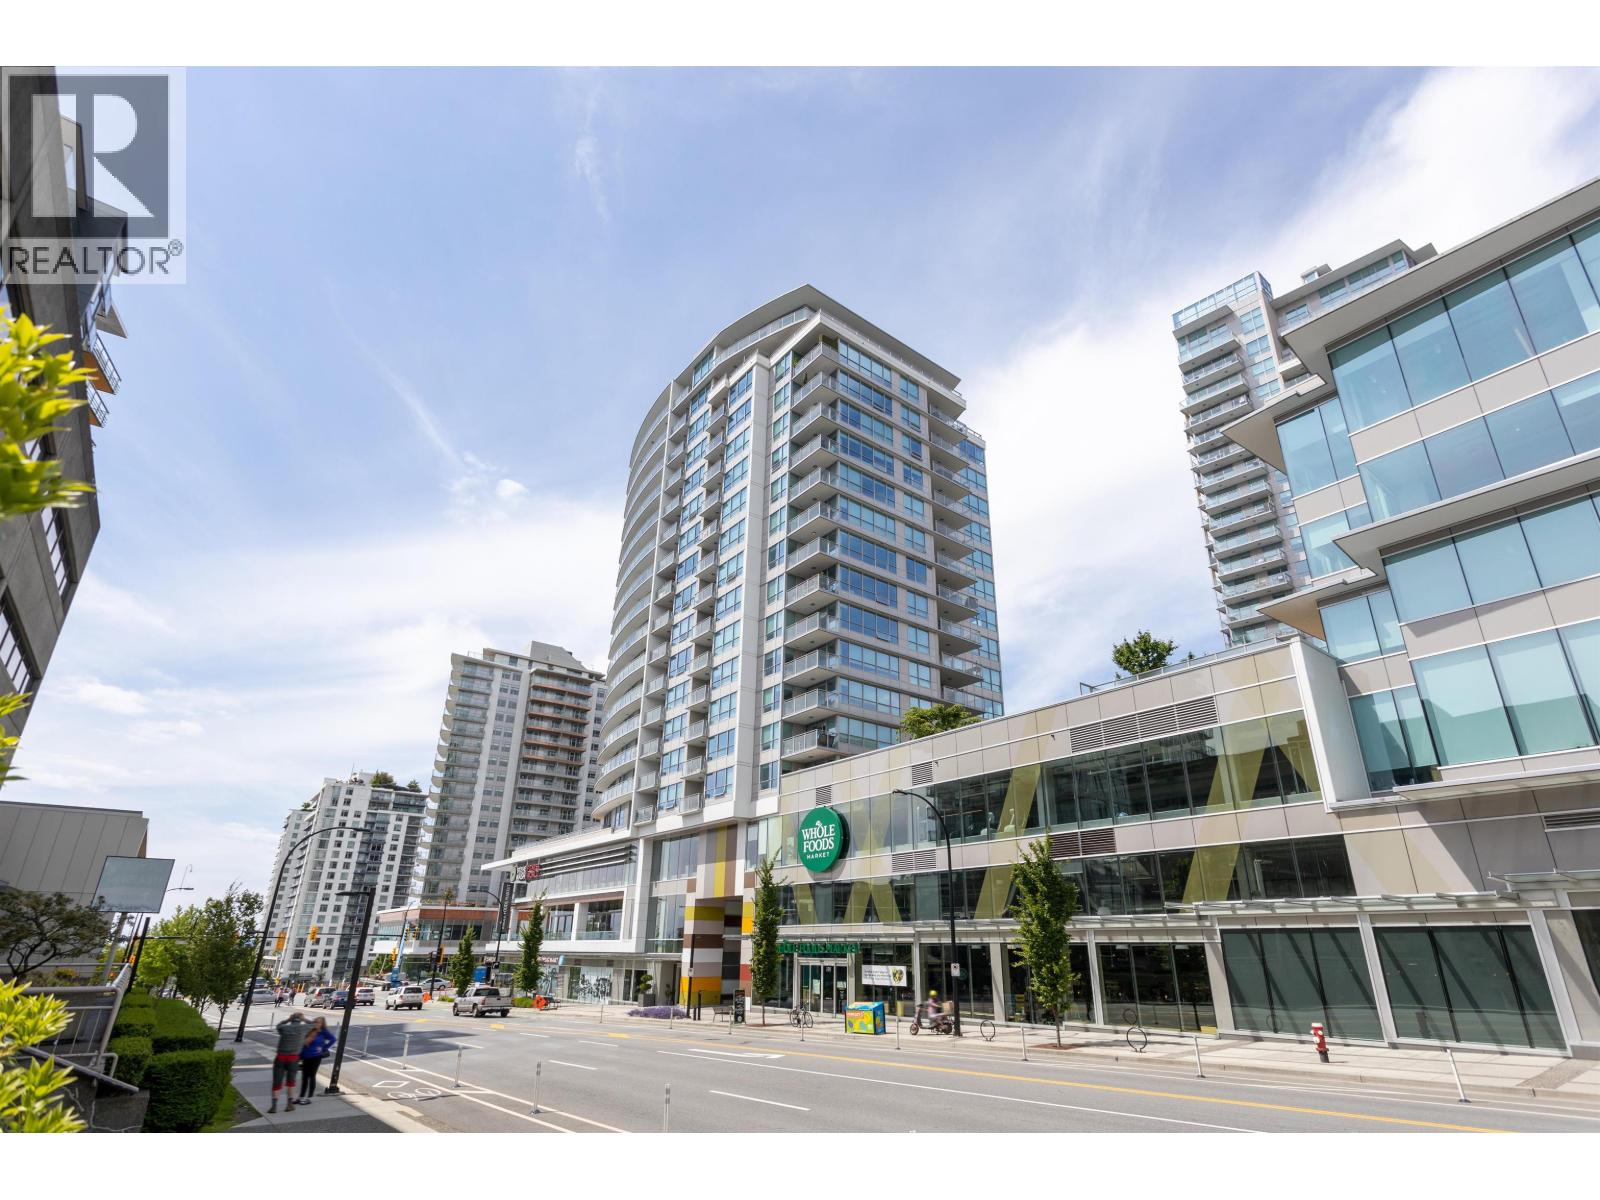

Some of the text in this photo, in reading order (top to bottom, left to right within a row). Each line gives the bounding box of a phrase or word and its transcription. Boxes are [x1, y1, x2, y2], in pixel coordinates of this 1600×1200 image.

[801, 823, 836, 841] WHOLE
[803, 837, 835, 853] FOODS
[806, 851, 830, 860] MARKET
